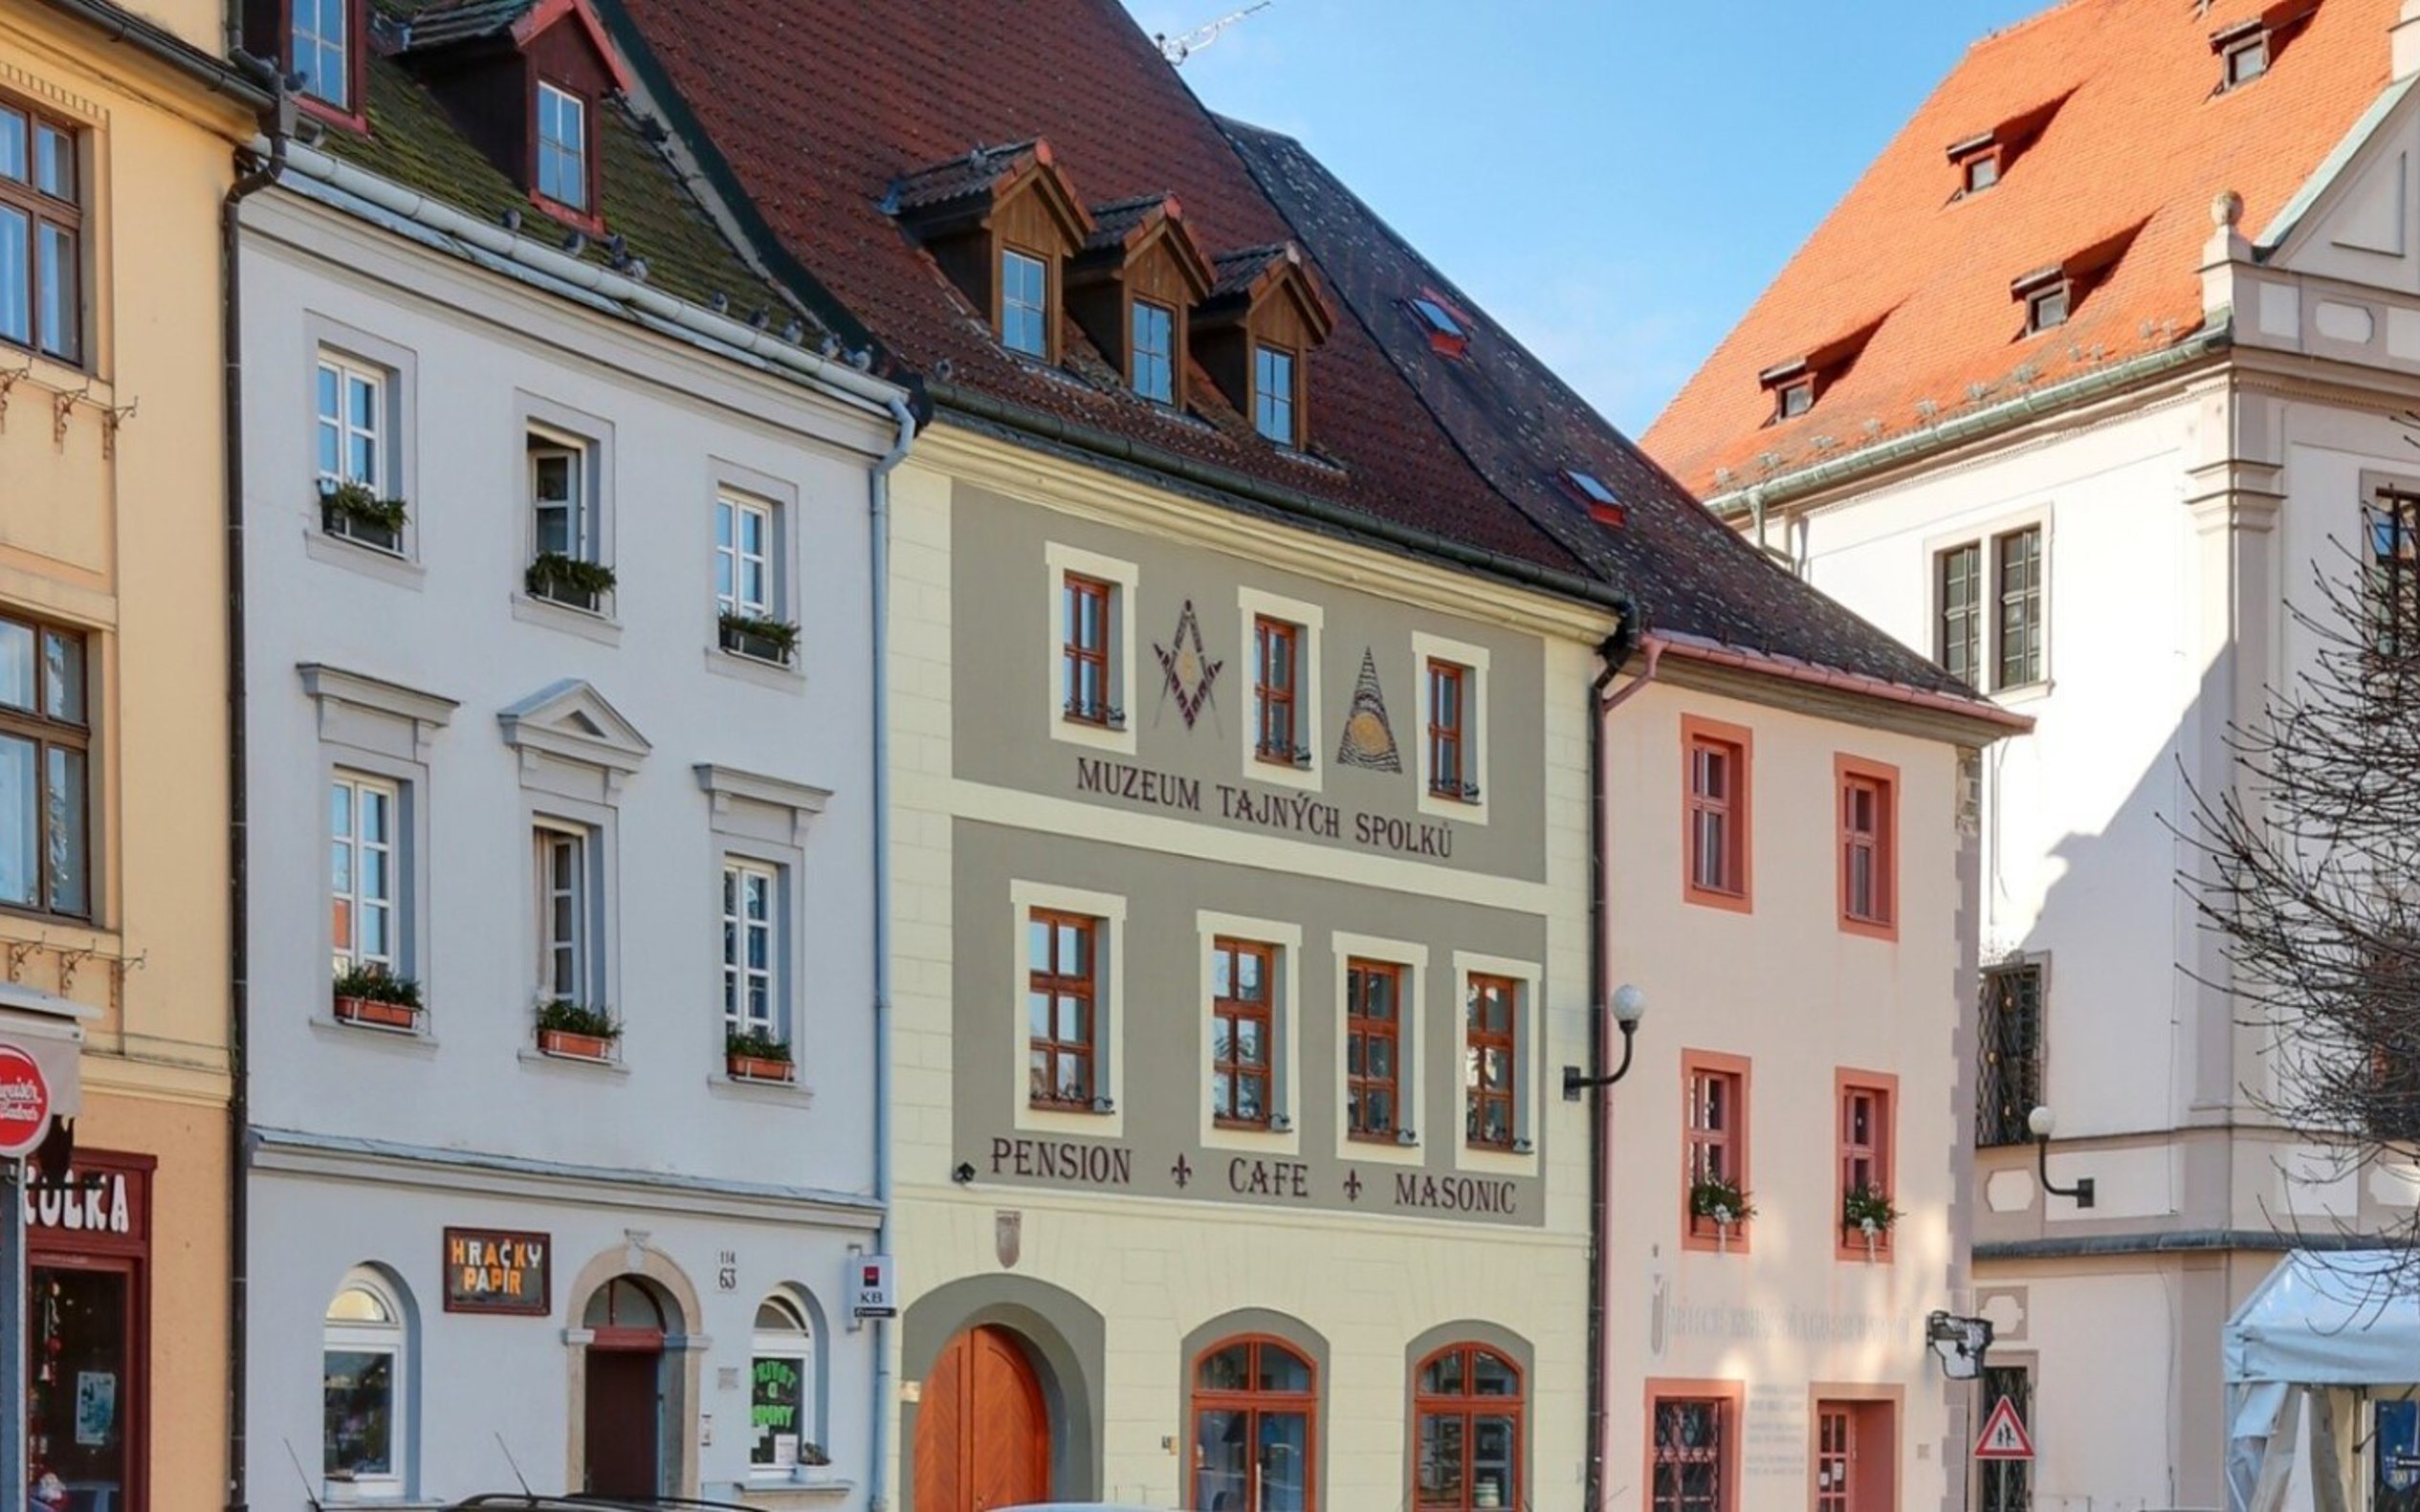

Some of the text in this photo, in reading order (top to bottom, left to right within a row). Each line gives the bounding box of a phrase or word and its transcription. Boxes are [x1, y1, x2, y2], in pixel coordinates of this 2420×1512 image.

[1077, 756, 1453, 858] MUZEUM TAJNÝCH SPOLKŮ
[991, 1137, 1517, 1215] PENSION CAFE MASONIC
[451, 1238, 542, 1268] HRAČKY
[719, 1267, 737, 1289] 63
[861, 1291, 883, 1304] KB
